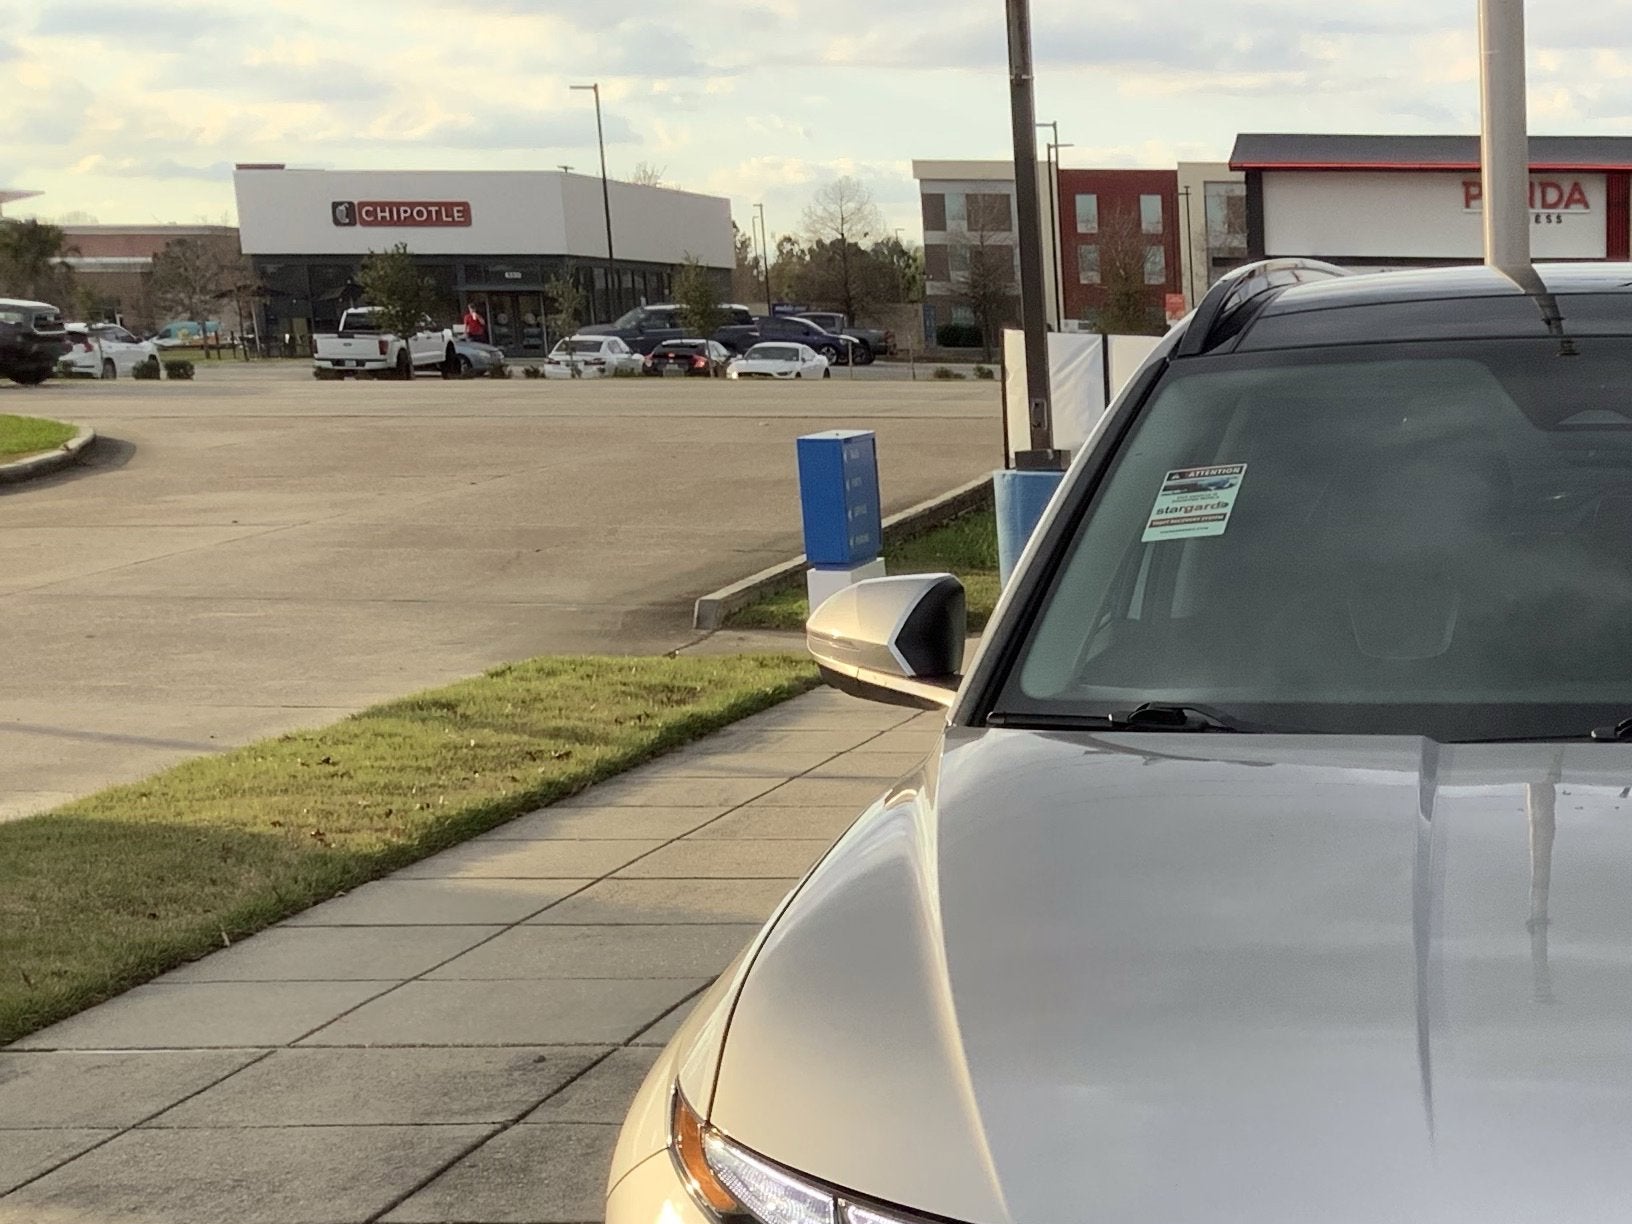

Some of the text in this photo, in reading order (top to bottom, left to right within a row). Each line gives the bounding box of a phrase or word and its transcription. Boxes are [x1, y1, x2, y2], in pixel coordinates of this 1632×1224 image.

[1462, 181, 1590, 209] PDA
[361, 206, 465, 221] CHIPOTLE
[1189, 467, 1241, 477] ATTENTION
